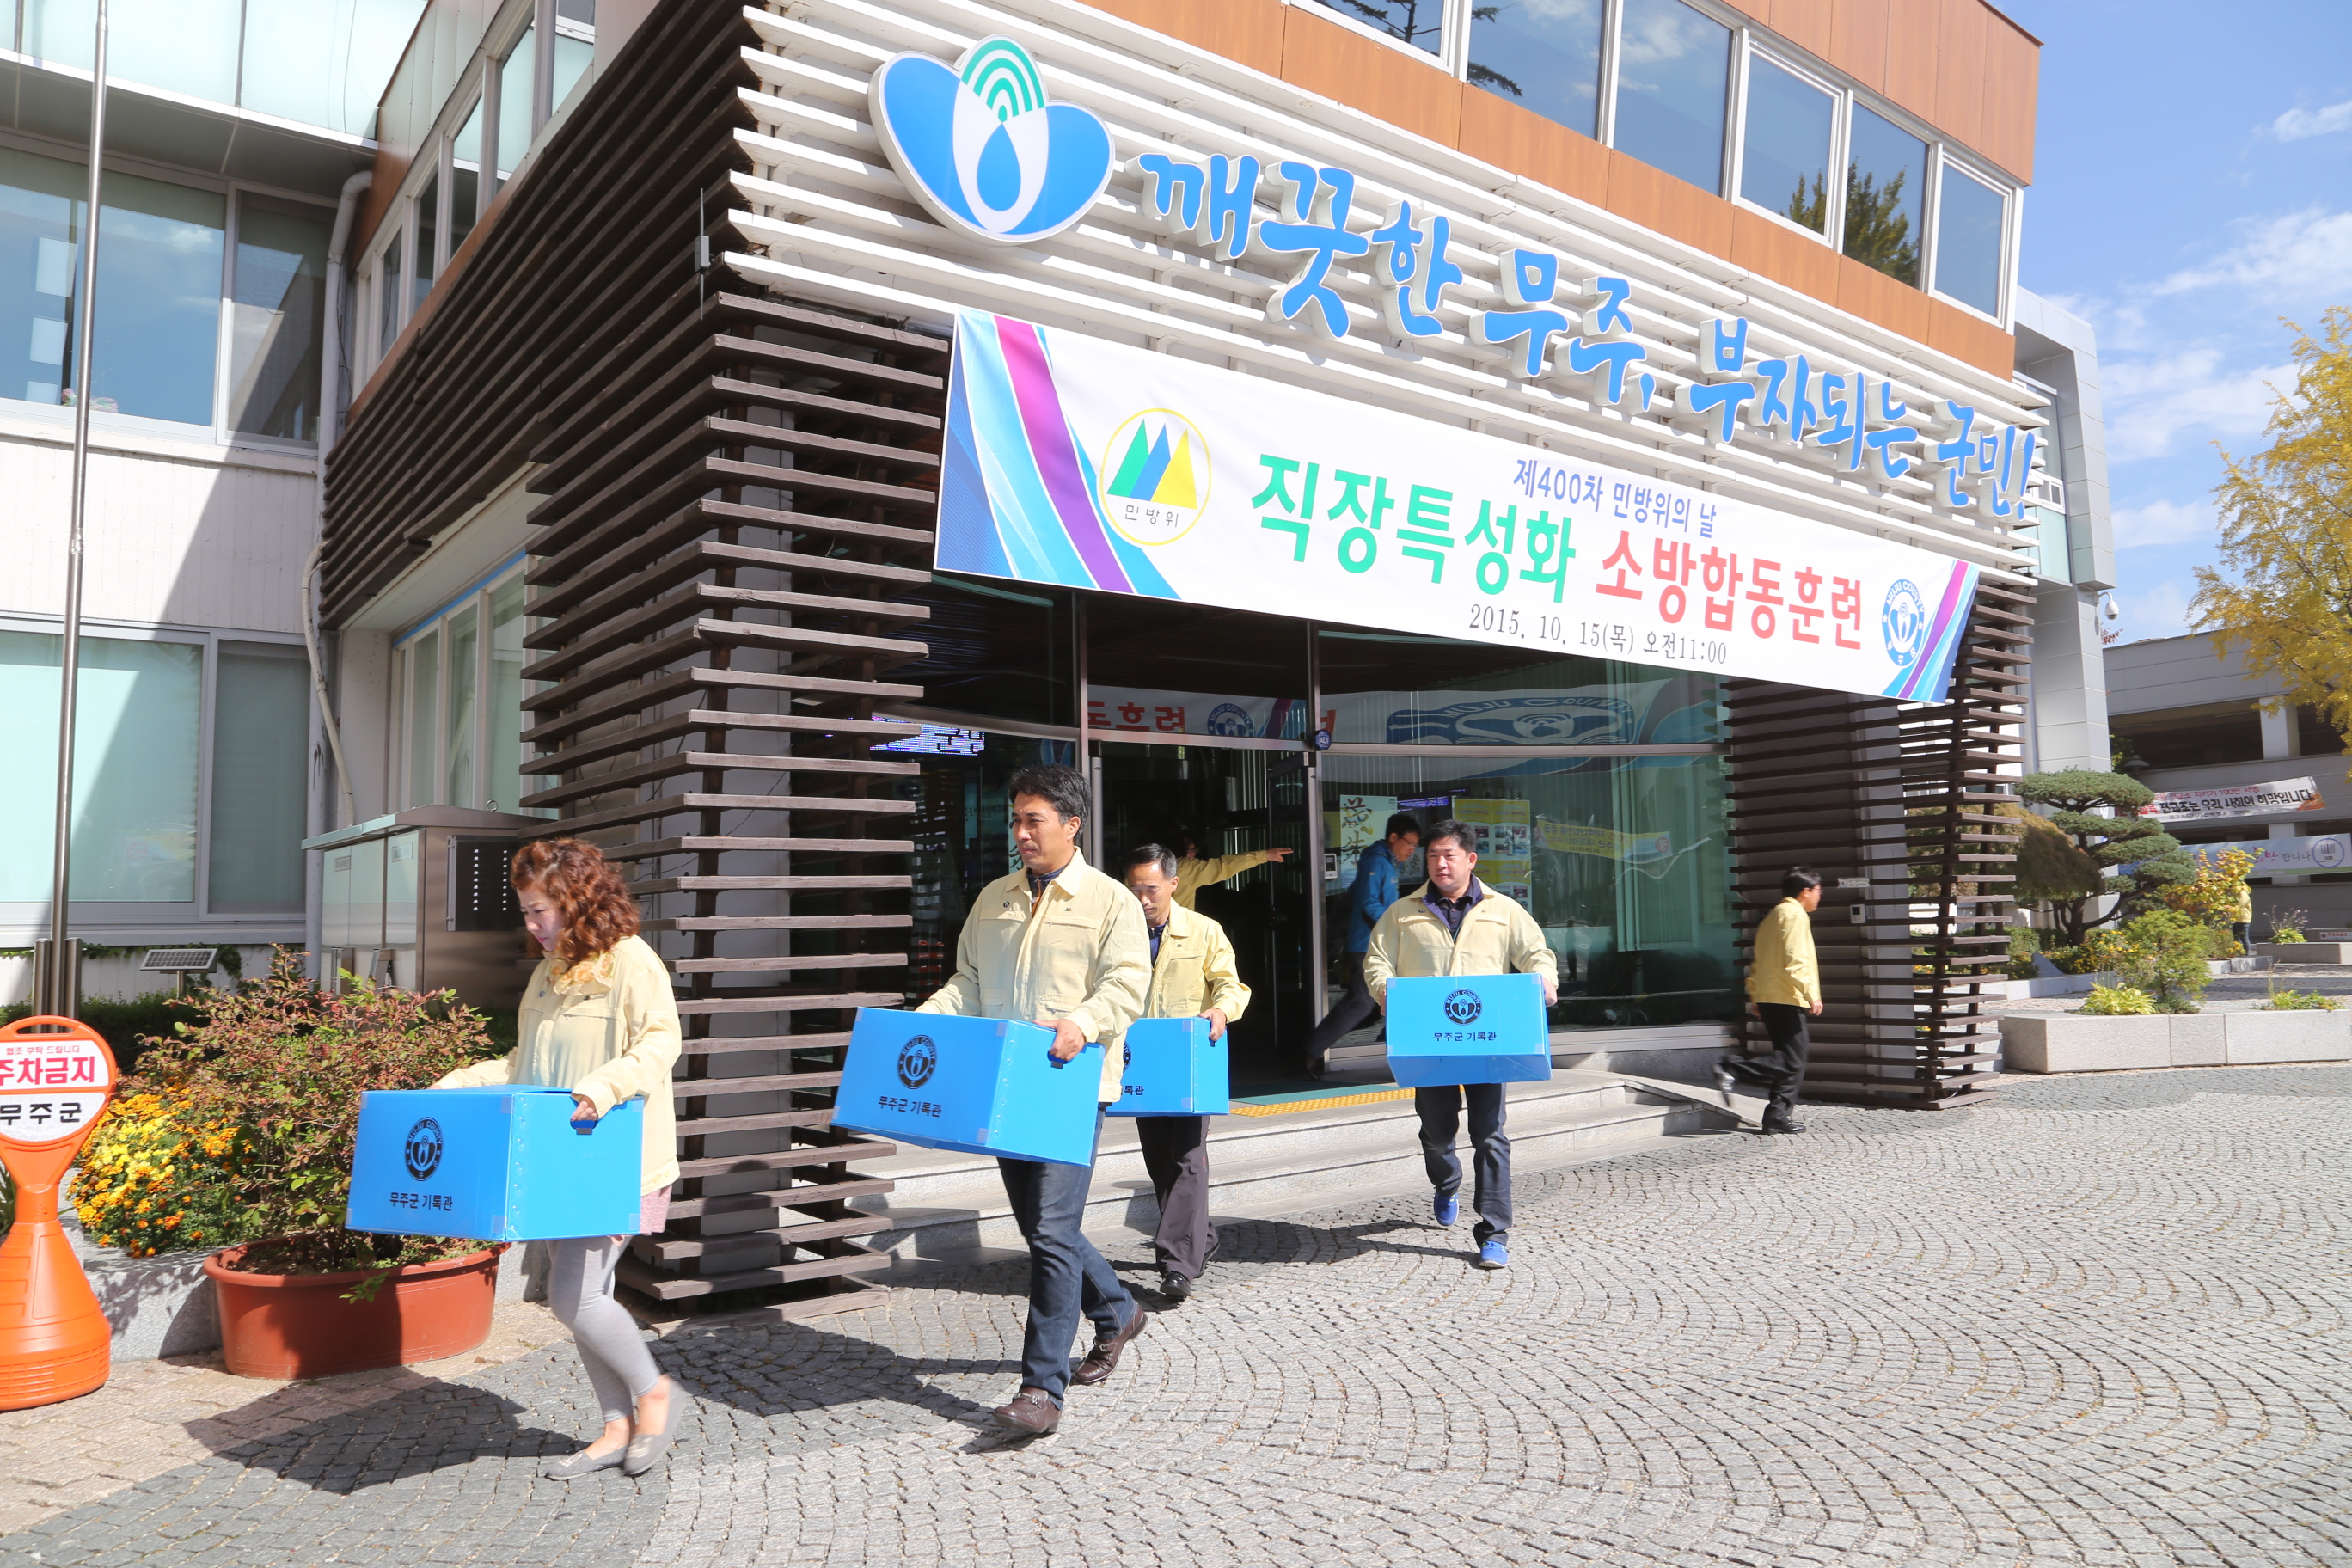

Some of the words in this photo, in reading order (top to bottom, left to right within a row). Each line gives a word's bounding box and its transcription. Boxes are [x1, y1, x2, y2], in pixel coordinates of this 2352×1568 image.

[1138, 153, 1463, 339] 깨끗한
[1482, 248, 1656, 412] 무주,
[1688, 317, 1919, 479] 부자되는
[1936, 400, 2036, 519] 군민!
[1513, 459, 1603, 512] 제400차
[1613, 482, 1691, 533] 민방위의
[1700, 503, 1717, 538] 날
[1124, 505, 1179, 528] 민방위
[1251, 454, 1576, 603] 직장특성화
[1596, 530, 1862, 650] 소방합동훈련
[1886, 581, 1902, 606] MUJU
[1902, 580, 1925, 612] COUNTY
[1469, 603, 1525, 639] 2015.
[1539, 614, 1566, 645] 10.
[1579, 621, 1634, 655] 15(목)
[1643, 630, 1727, 665] 오전11:00
[2159, 800, 2201, 813] 전교조는
[2202, 799, 2224, 811] 우리
[2194, 790, 2217, 799] 지키기
[2282, 851, 2312, 863] 합니다
[1446, 991, 1461, 1004] MUJU
[1433, 1032, 1463, 1042] 무주군
[1467, 1032, 1497, 1042] 기록관
[6, 1047, 23, 1056] 협조
[27, 1046, 44, 1055] 부탁
[46, 1045, 80, 1054] 드립니다
[0, 1056, 95, 1086] 주차금지
[0, 1102, 82, 1126] 무주군
[878, 1095, 909, 1113] 무주군
[910, 1099, 942, 1118] 기록관
[407, 1121, 425, 1143] MUJU
[389, 1191, 420, 1210] 무주군
[422, 1193, 453, 1212] 기록관
